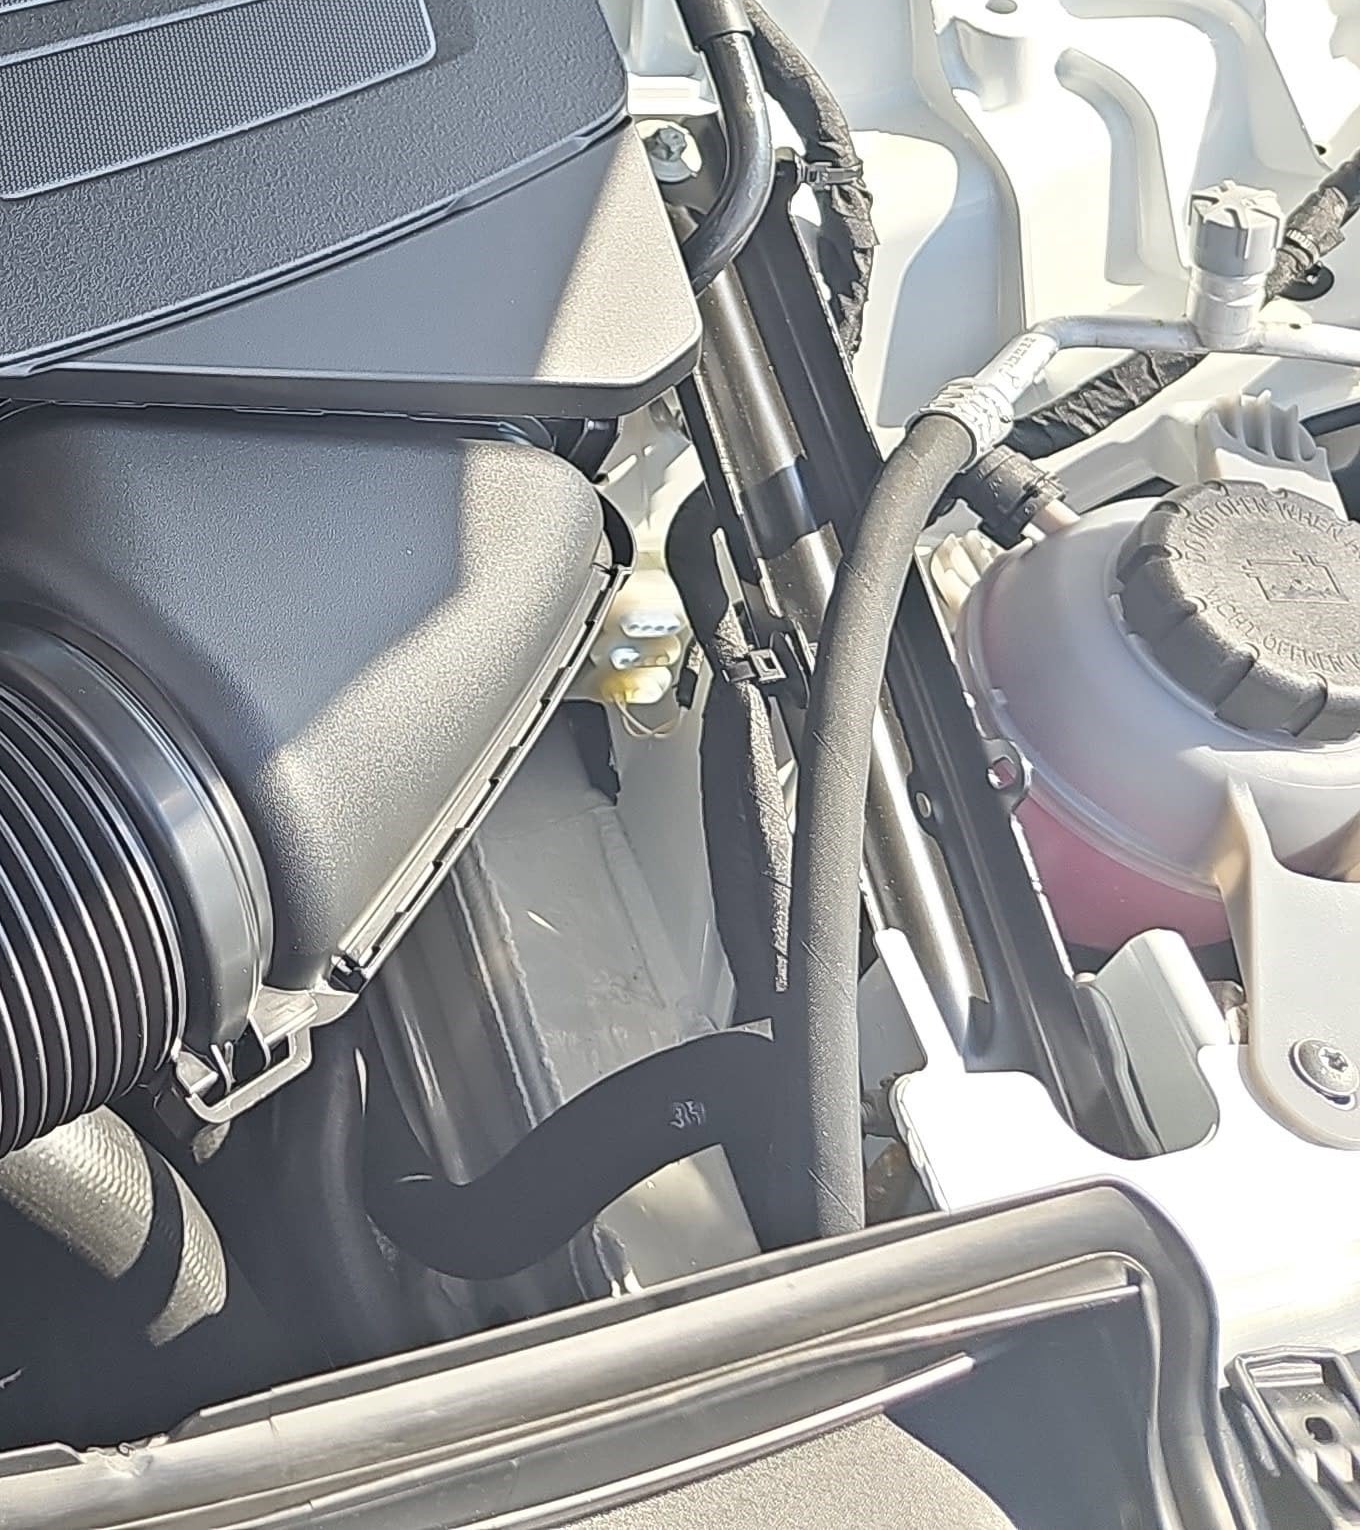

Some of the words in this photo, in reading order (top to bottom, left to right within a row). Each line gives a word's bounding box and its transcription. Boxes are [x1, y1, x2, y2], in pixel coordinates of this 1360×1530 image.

[1186, 505, 1219, 540] NOT
[1215, 495, 1270, 517] OPEN
[1275, 499, 1345, 543] WHEN
